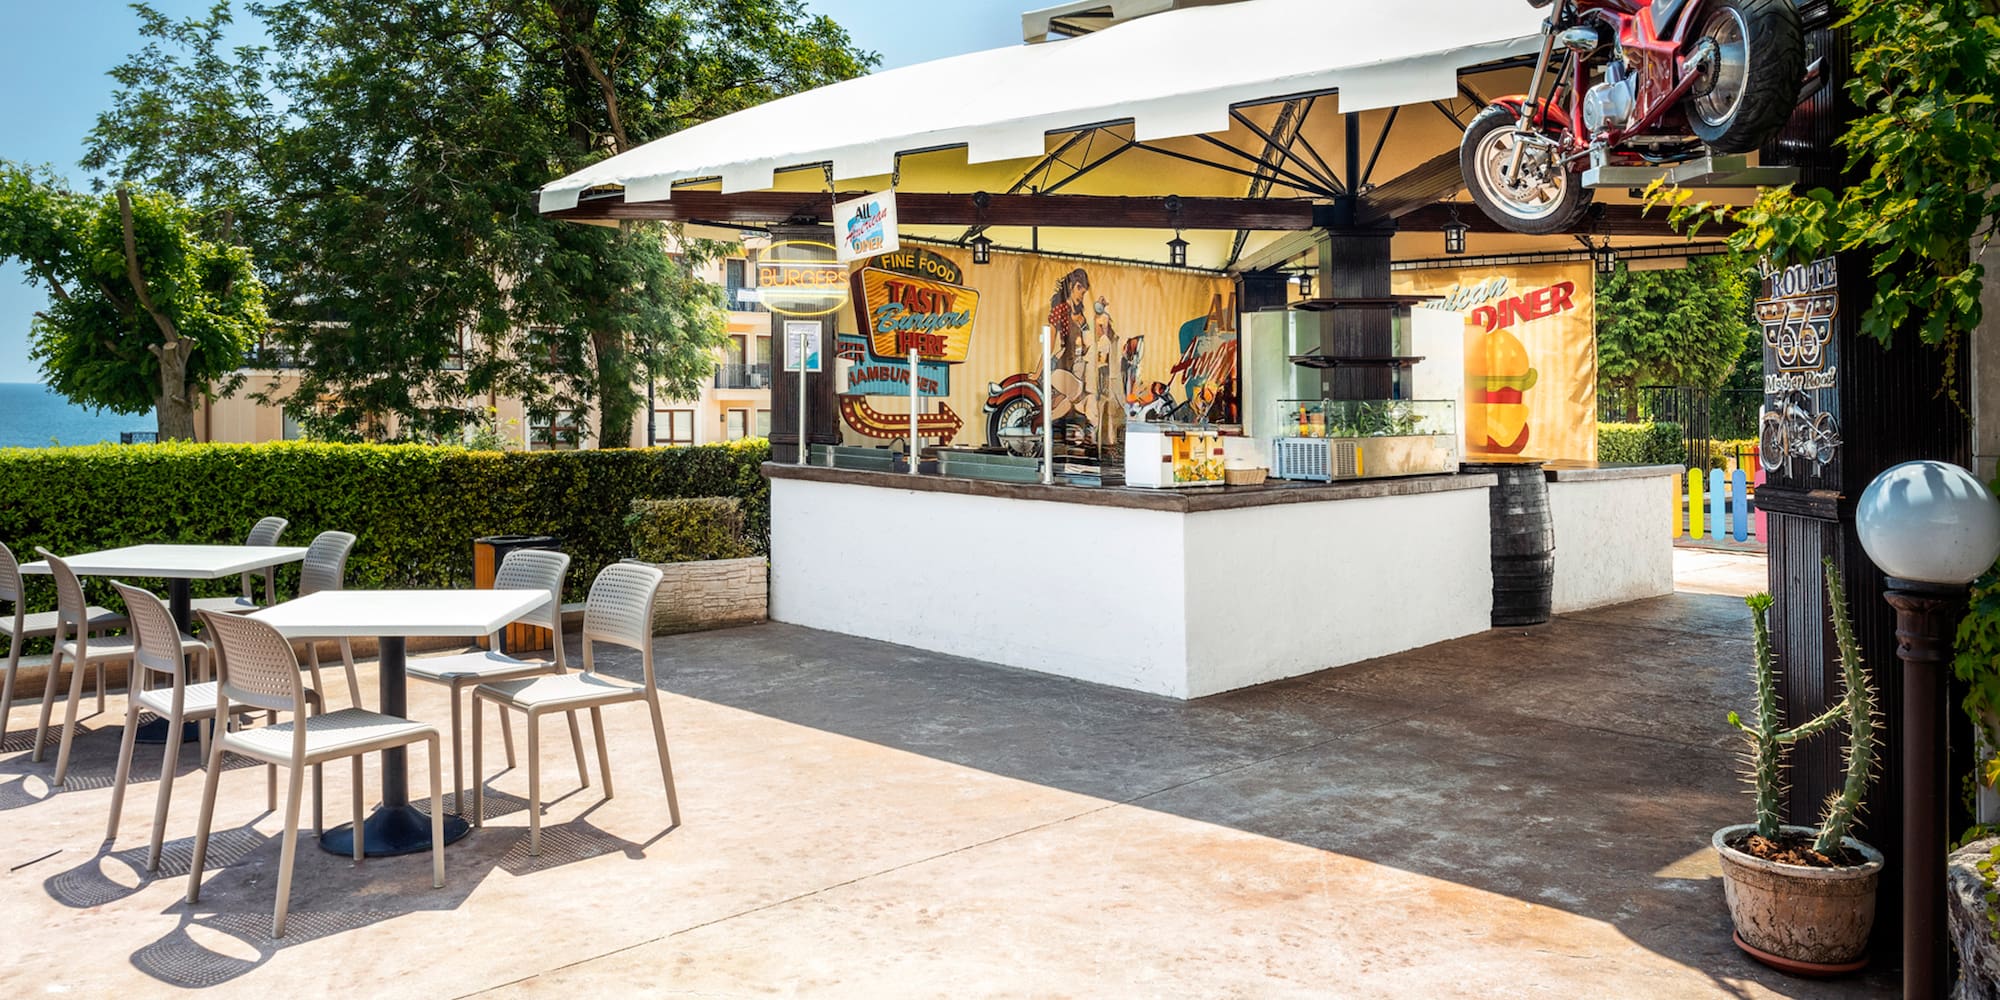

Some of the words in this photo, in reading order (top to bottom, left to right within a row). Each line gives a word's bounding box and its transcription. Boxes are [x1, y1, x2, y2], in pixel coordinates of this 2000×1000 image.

[853, 235, 883, 254] DINER
[760, 268, 848, 288] BURGERS
[881, 254, 915, 269] FINE
[919, 258, 955, 283] FOOD
[1769, 256, 1837, 299] ROUTE
[886, 281, 957, 316] TASTY
[1471, 281, 1575, 333] DINER
[895, 331, 948, 357] HERE
[1777, 300, 1820, 365] 66
[1764, 372, 1804, 393] Mother
[1804, 366, 1837, 390] Road
